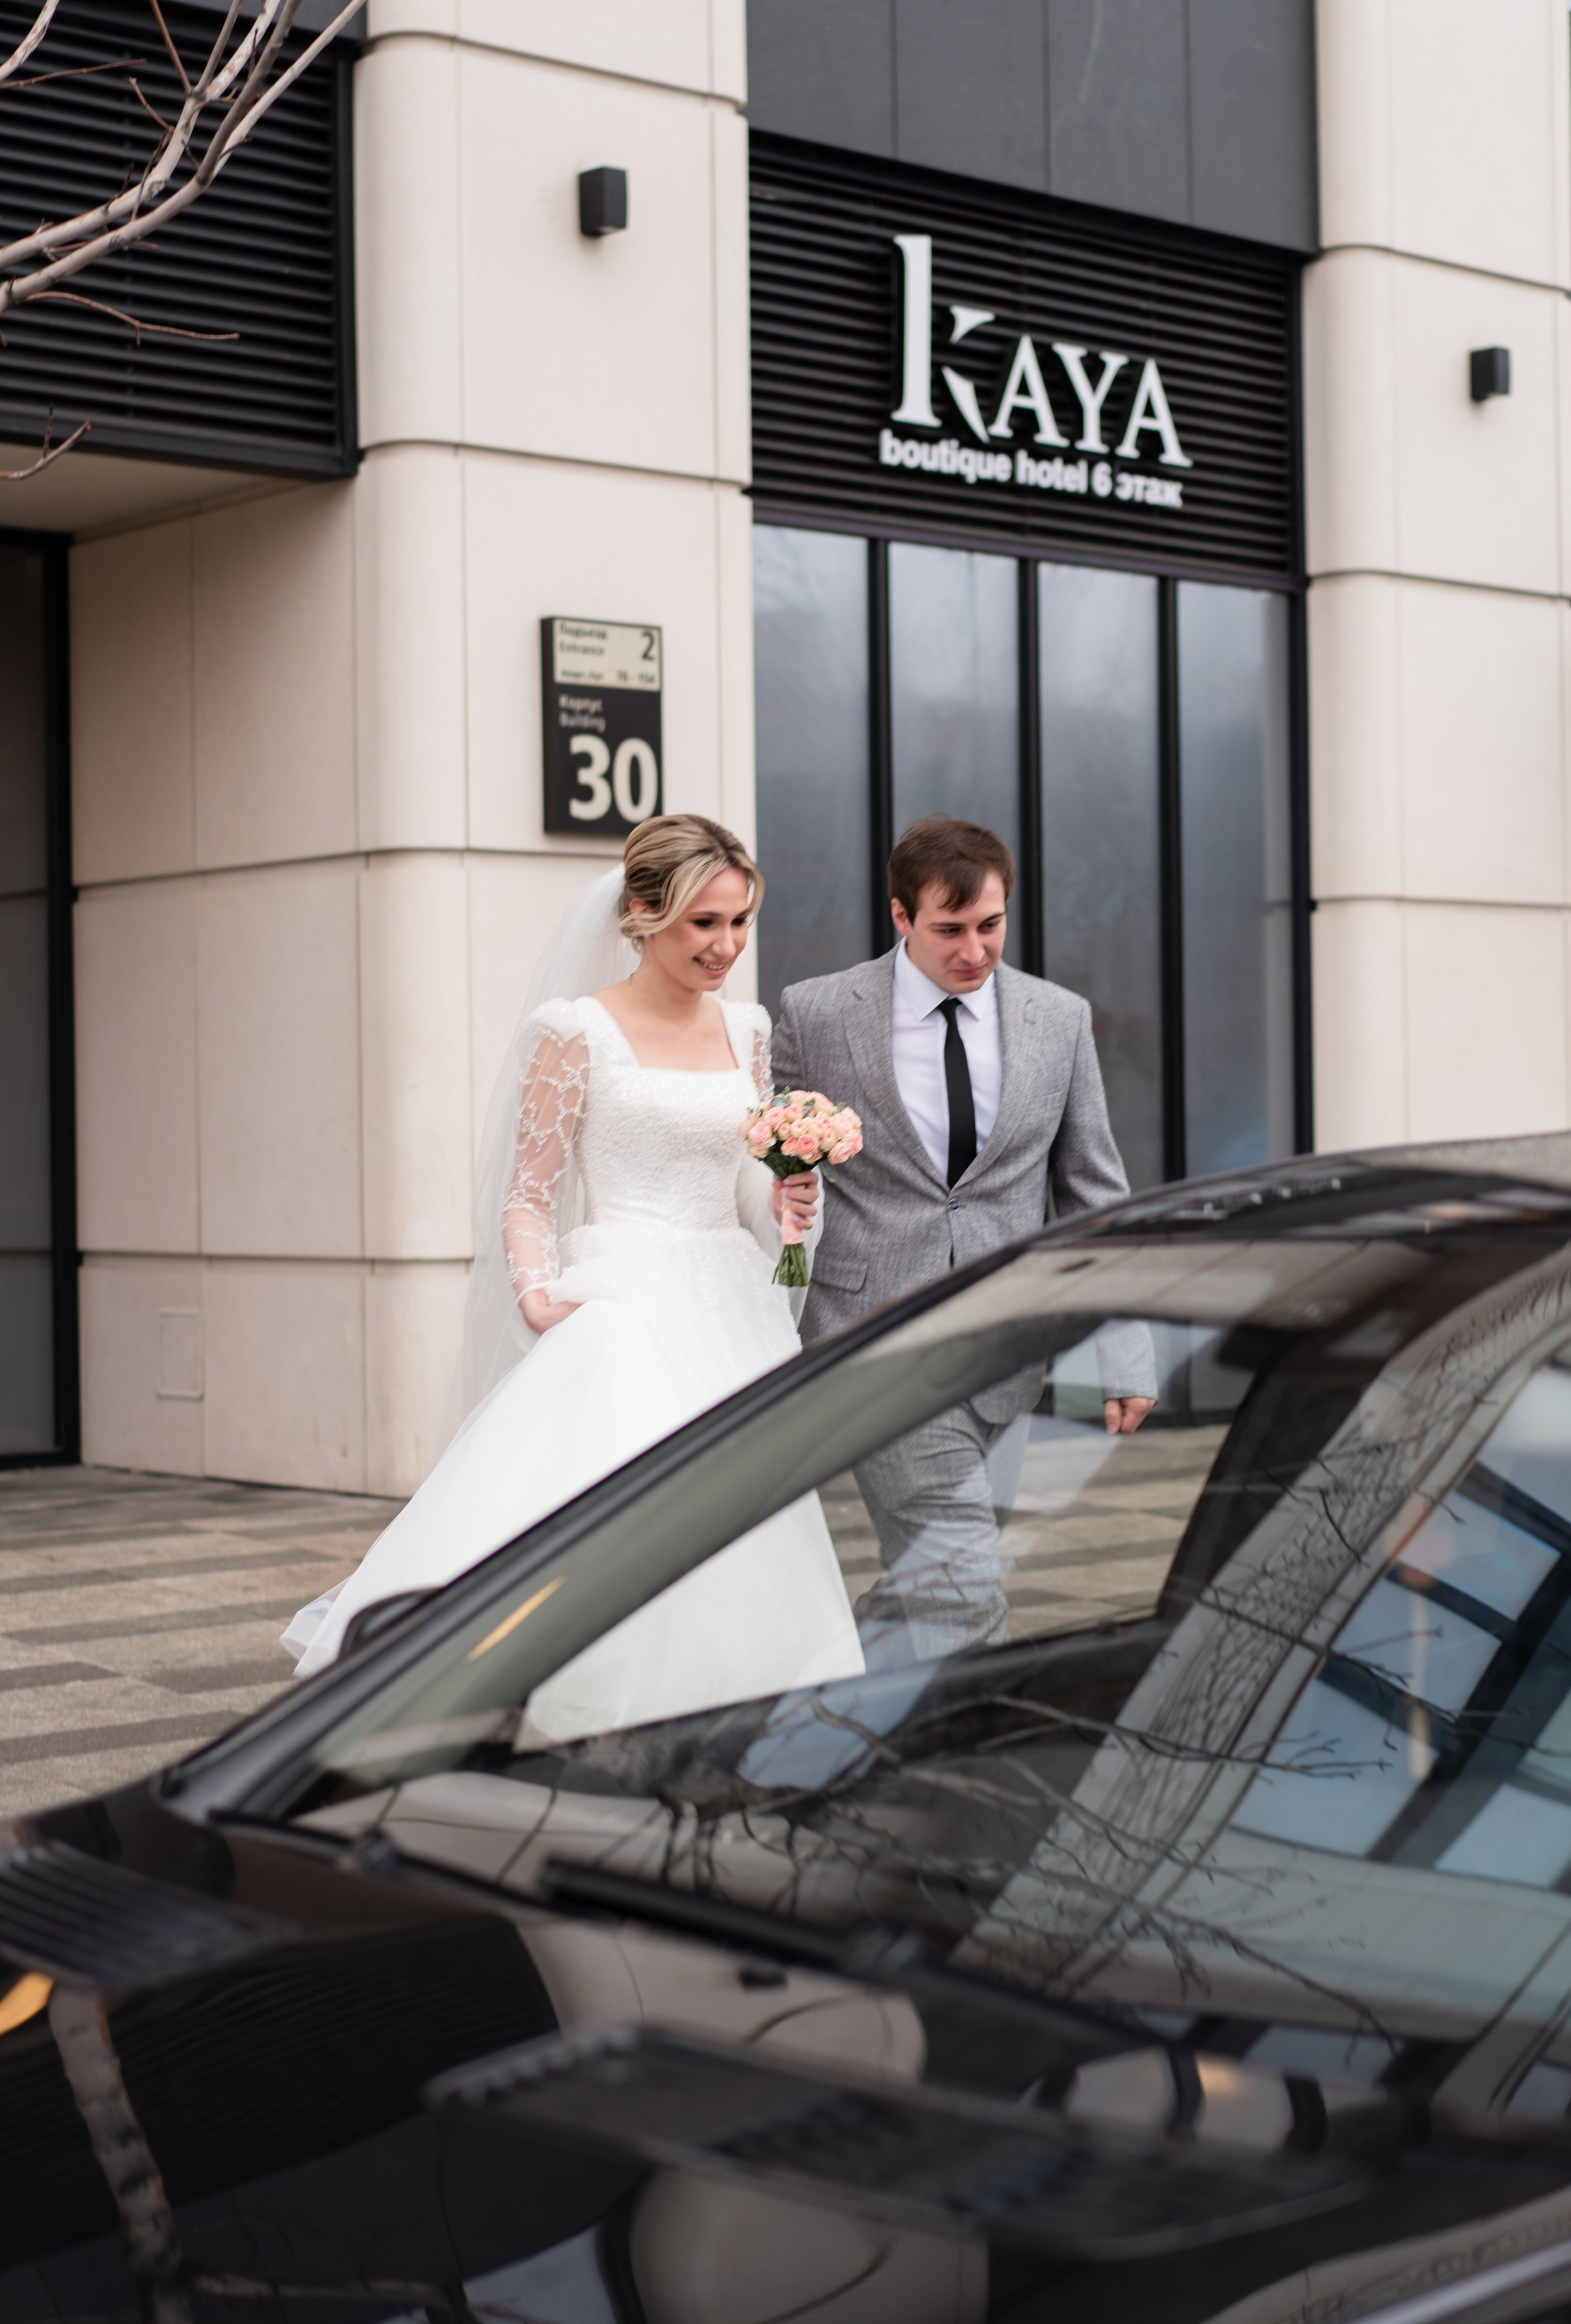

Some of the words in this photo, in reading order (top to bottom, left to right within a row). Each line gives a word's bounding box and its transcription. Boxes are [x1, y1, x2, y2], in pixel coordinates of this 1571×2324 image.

[879, 428, 1013, 484] boutique
[1016, 449, 1090, 495] hotel
[1091, 461, 1113, 498] 6
[642, 630, 655, 661] 2
[568, 732, 659, 824] 30
